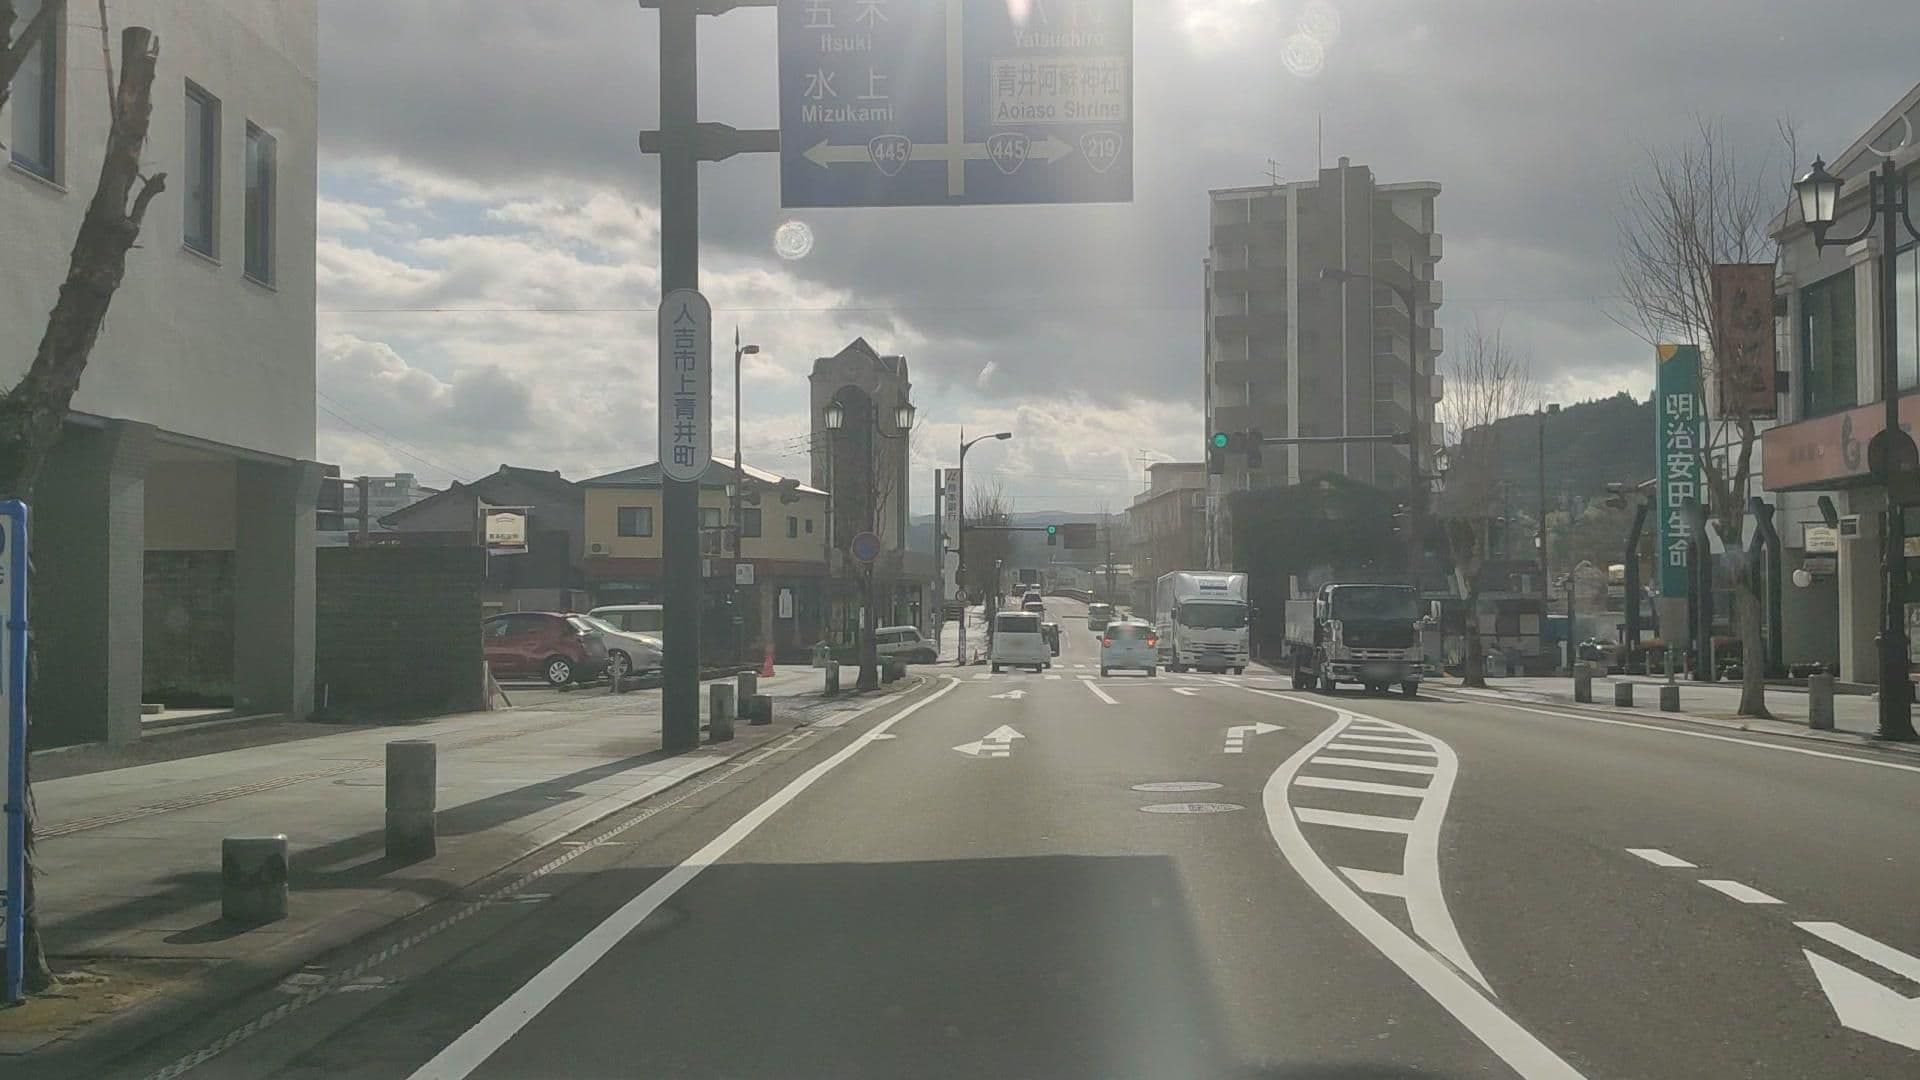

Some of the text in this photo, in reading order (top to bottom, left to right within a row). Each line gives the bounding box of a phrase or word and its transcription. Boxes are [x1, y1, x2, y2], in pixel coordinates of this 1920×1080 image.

[820, 33, 872, 52] Itsuki
[802, 67, 889, 101] 水上
[999, 63, 1121, 97] 青井阿蘇神社
[801, 104, 896, 123] Mizukami
[998, 100, 1121, 119] Aoiaso Shrine
[874, 143, 906, 161] 445
[993, 140, 1024, 159] 445
[1087, 136, 1115, 158] 219
[673, 303, 697, 468] 人吉市上青井町
[1665, 392, 1694, 568] 明治安田生命
